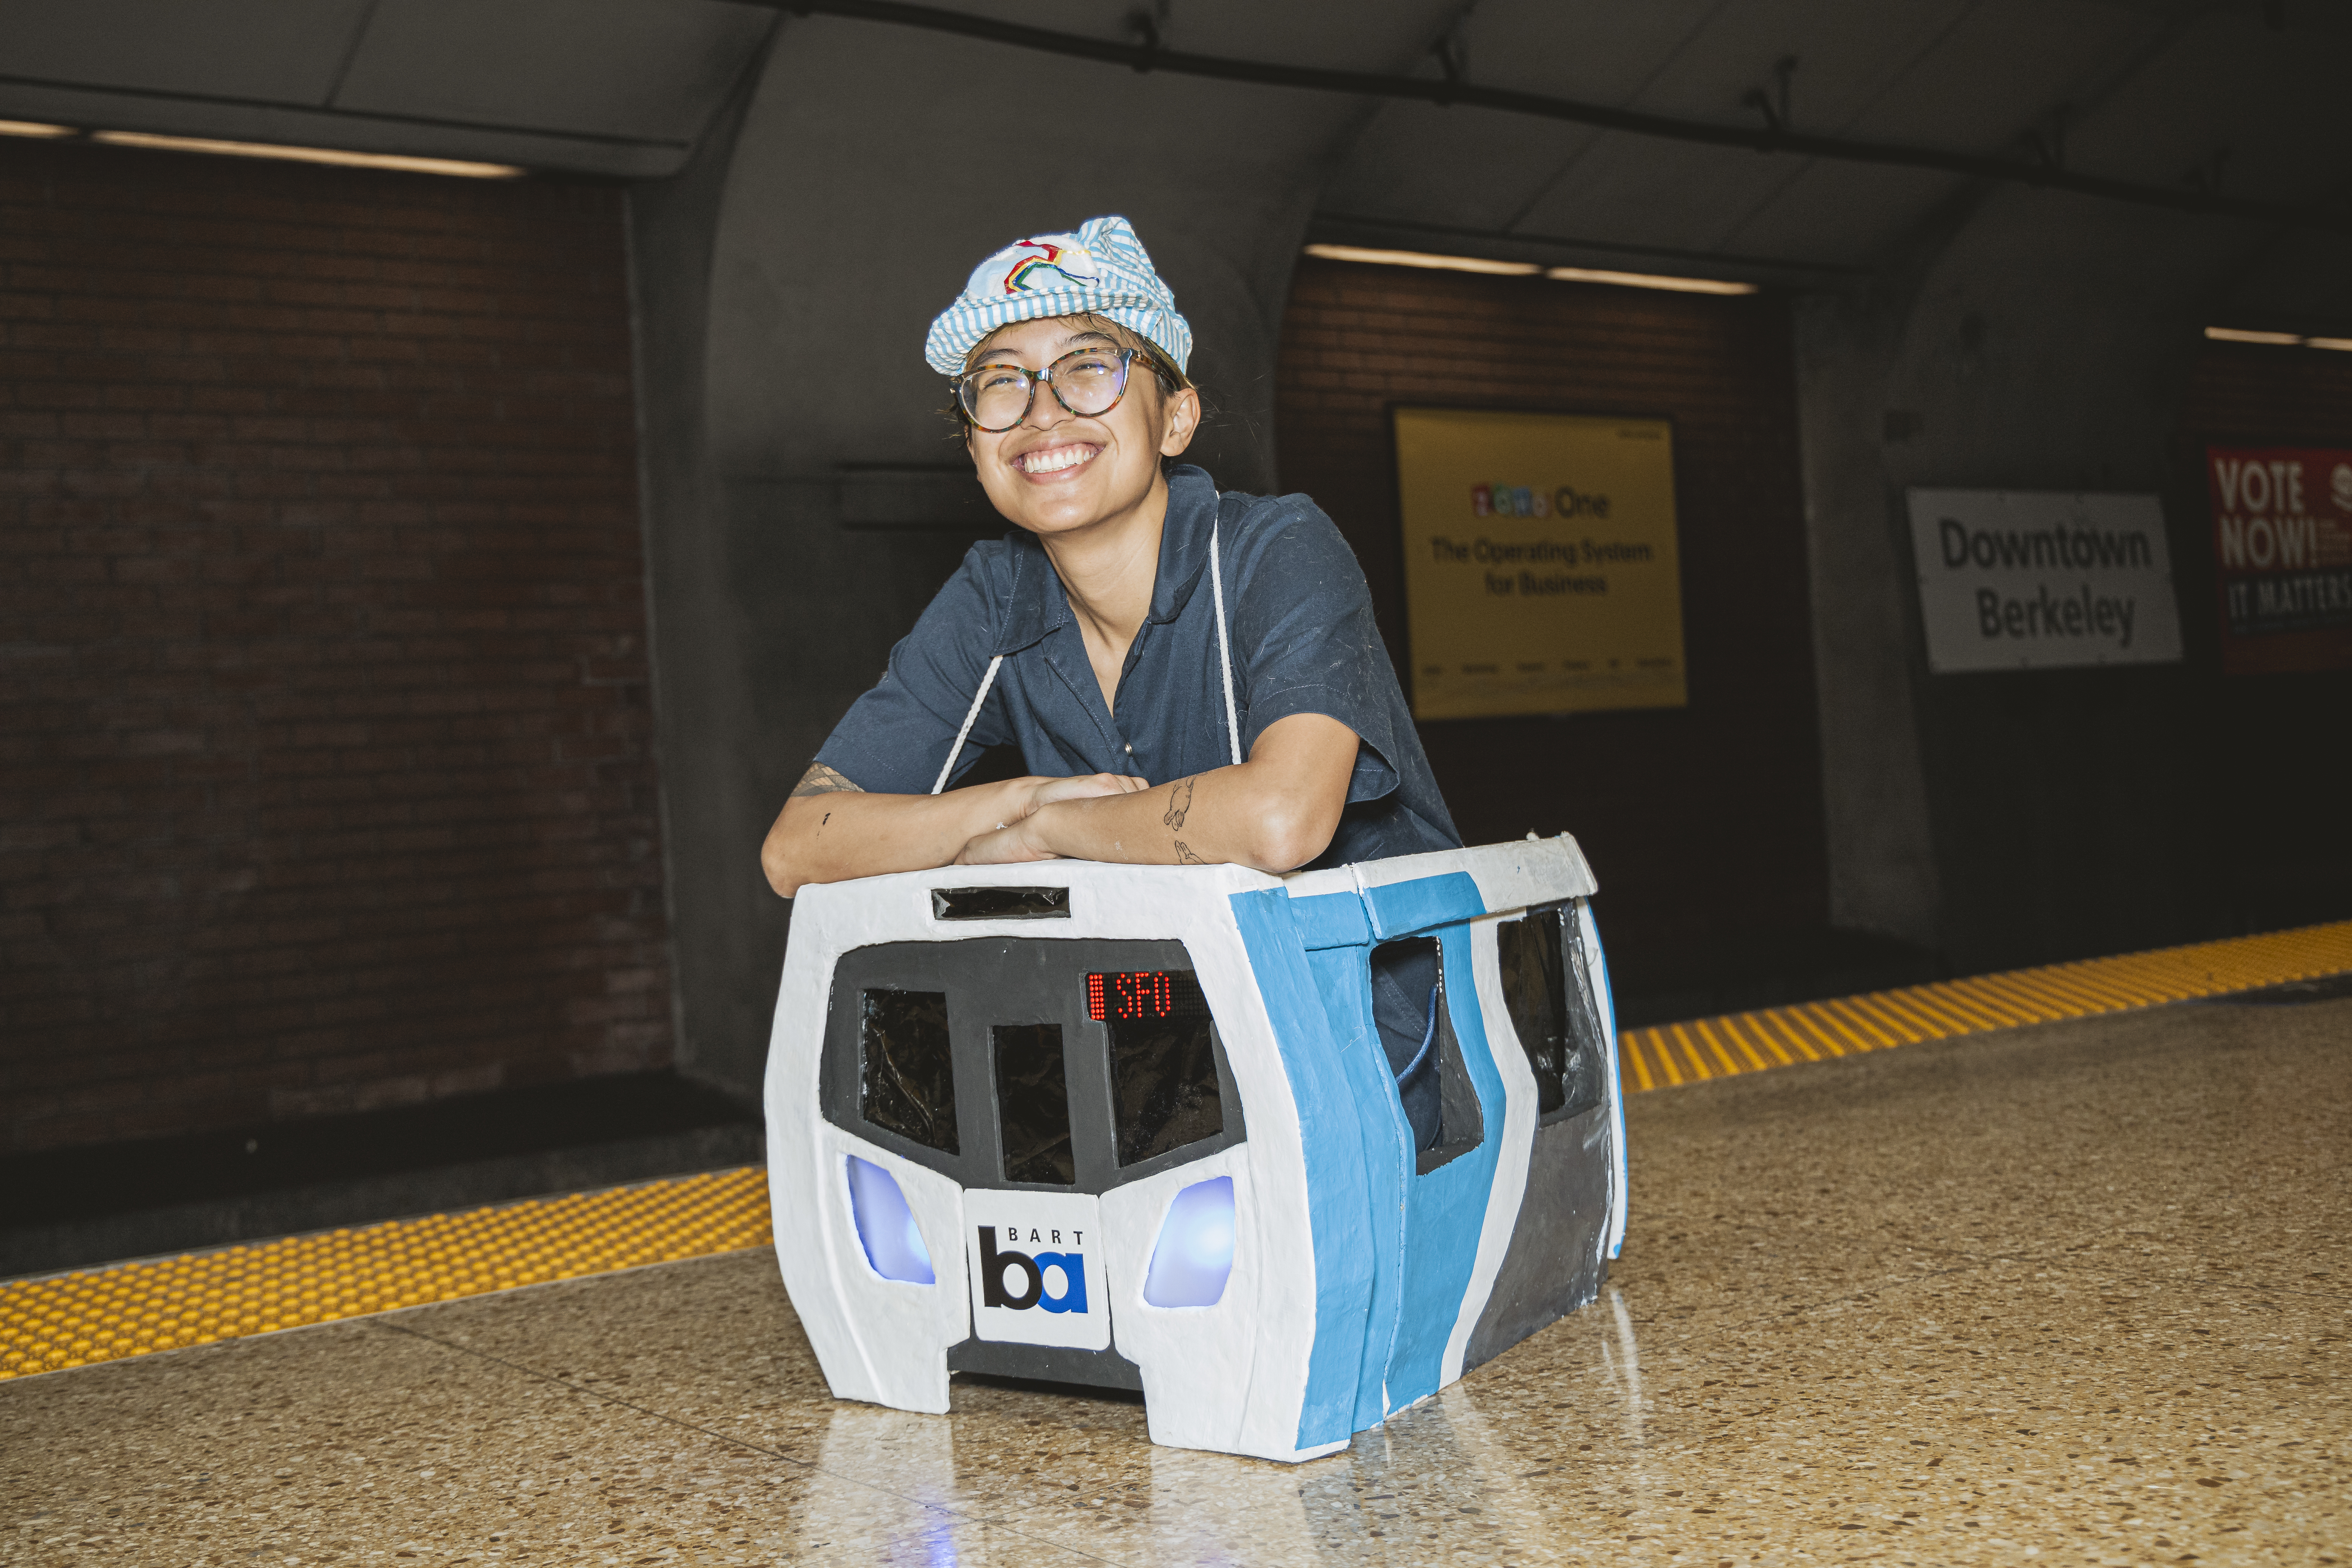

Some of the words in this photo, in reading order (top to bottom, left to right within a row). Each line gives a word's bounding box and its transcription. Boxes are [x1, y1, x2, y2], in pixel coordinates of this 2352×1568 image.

[1556, 486, 1610, 518] One
[2214, 457, 2303, 513] VOTE
[1431, 537, 1469, 562] The
[1473, 538, 1576, 566] Operating
[1582, 539, 1652, 564] System
[1940, 518, 2153, 569] Downtown
[2220, 515, 2318, 569] NOW!
[1485, 571, 1514, 595] for
[1518, 572, 1608, 596] Business
[2228, 581, 2248, 619] IT
[1977, 585, 2133, 648] Berkeley
[1116, 972, 1171, 1018] SFO
[1008, 1227, 1083, 1245] BART
[978, 1225, 1088, 1314] ba
